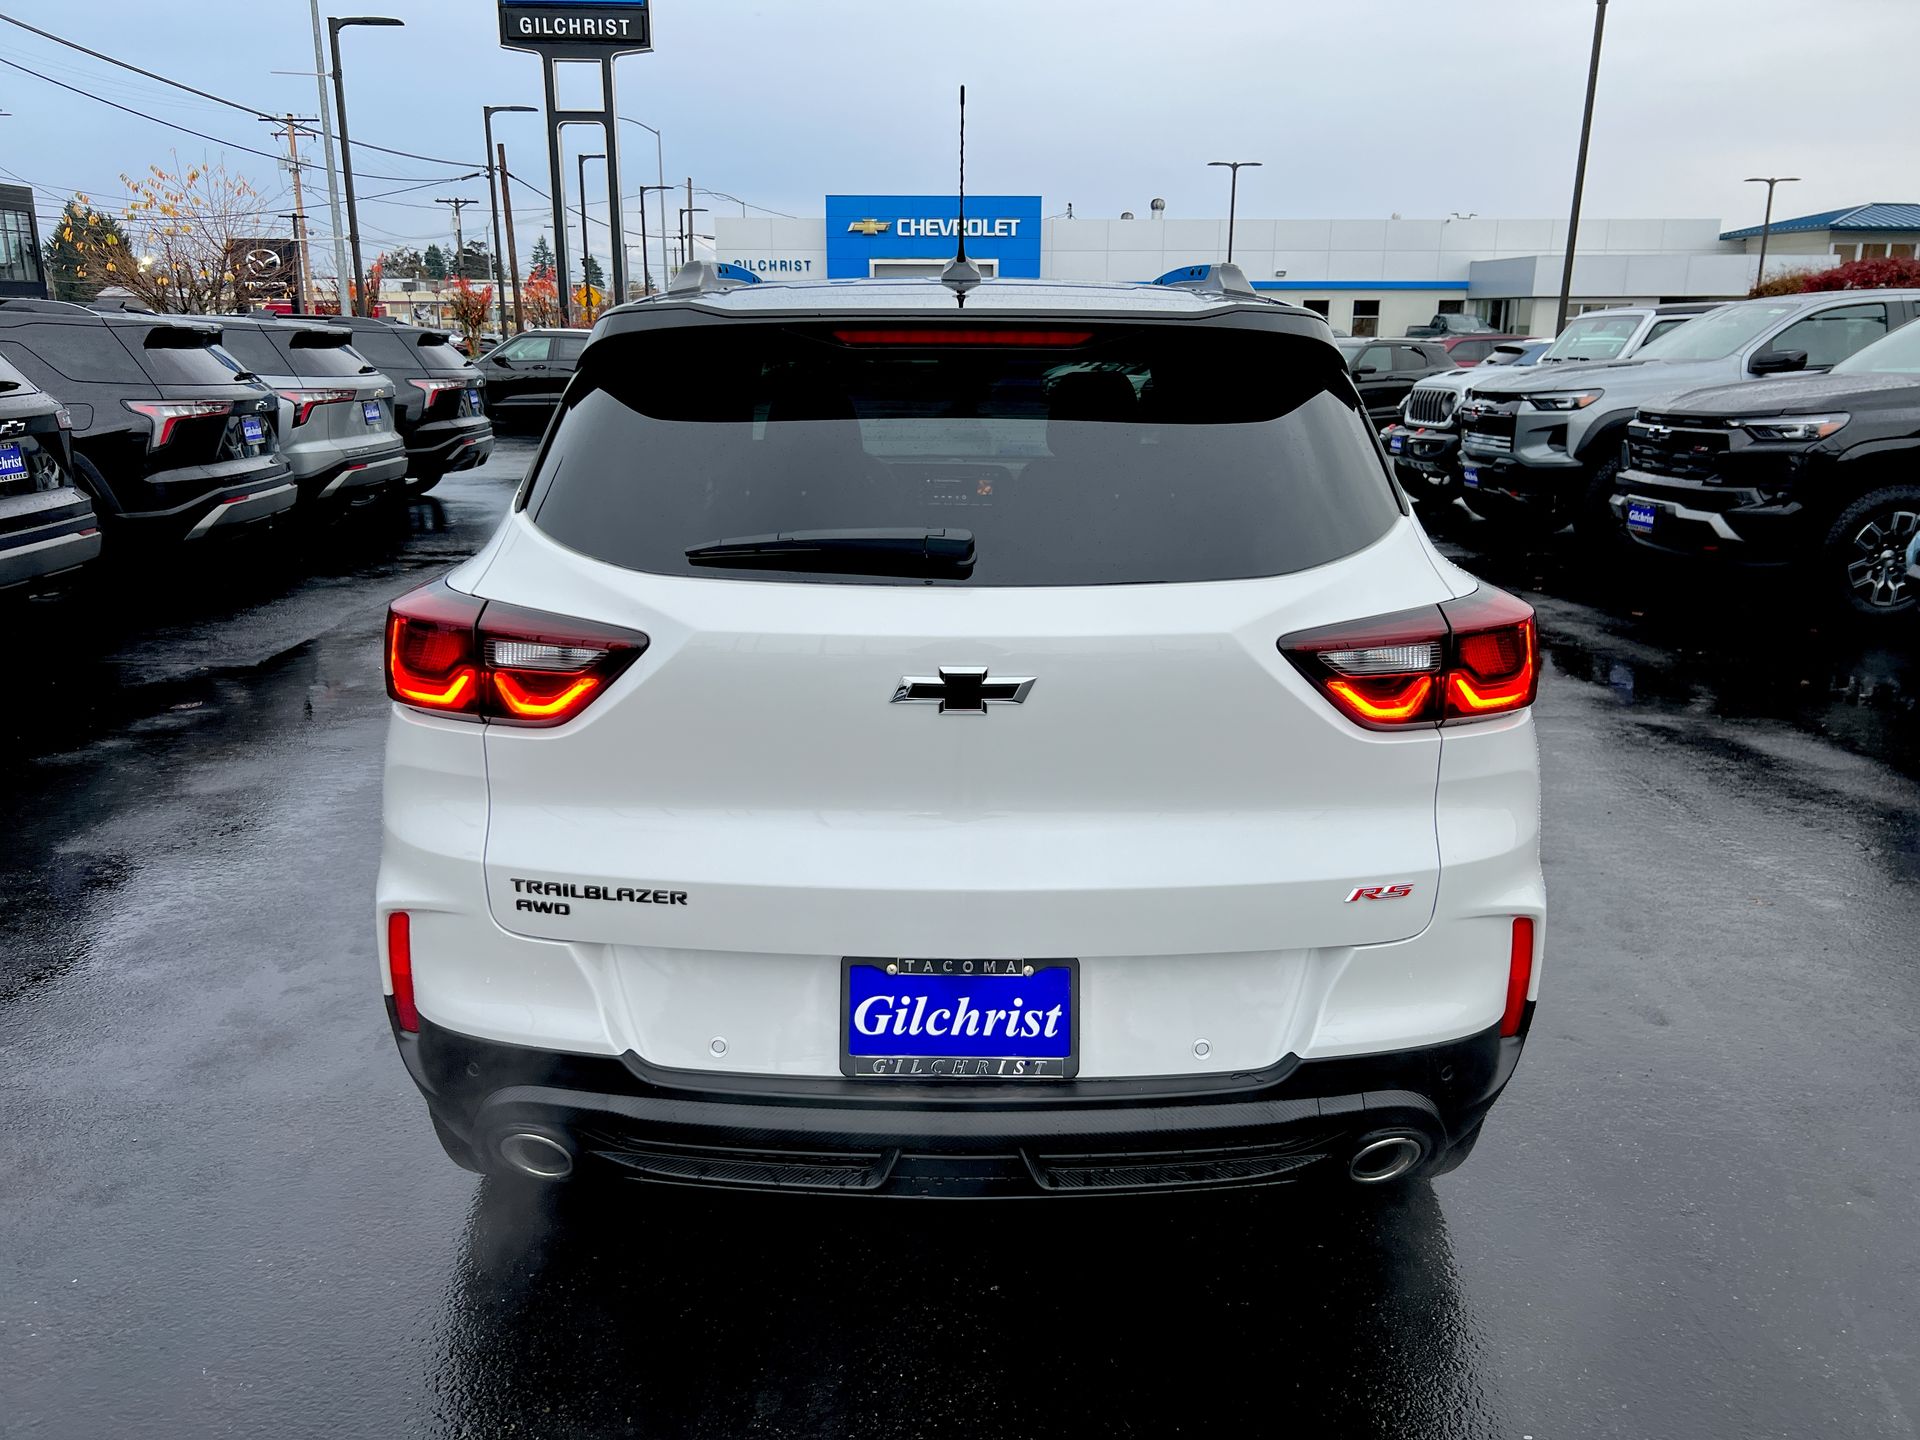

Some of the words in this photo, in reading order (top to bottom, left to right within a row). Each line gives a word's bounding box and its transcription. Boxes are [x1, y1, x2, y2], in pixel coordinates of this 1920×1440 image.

[519, 17, 630, 36] GILCHRIST
[896, 218, 1021, 236] CHEVROLET
[1628, 509, 1655, 525] Gilchrist
[510, 878, 688, 905] TRAILBLAZER
[1344, 883, 1415, 903] RS
[515, 898, 571, 916] AWD
[904, 959, 1017, 974] TACOMA
[853, 995, 1063, 1038] Gilchrist
[872, 1058, 1048, 1075] GILCHRIST
